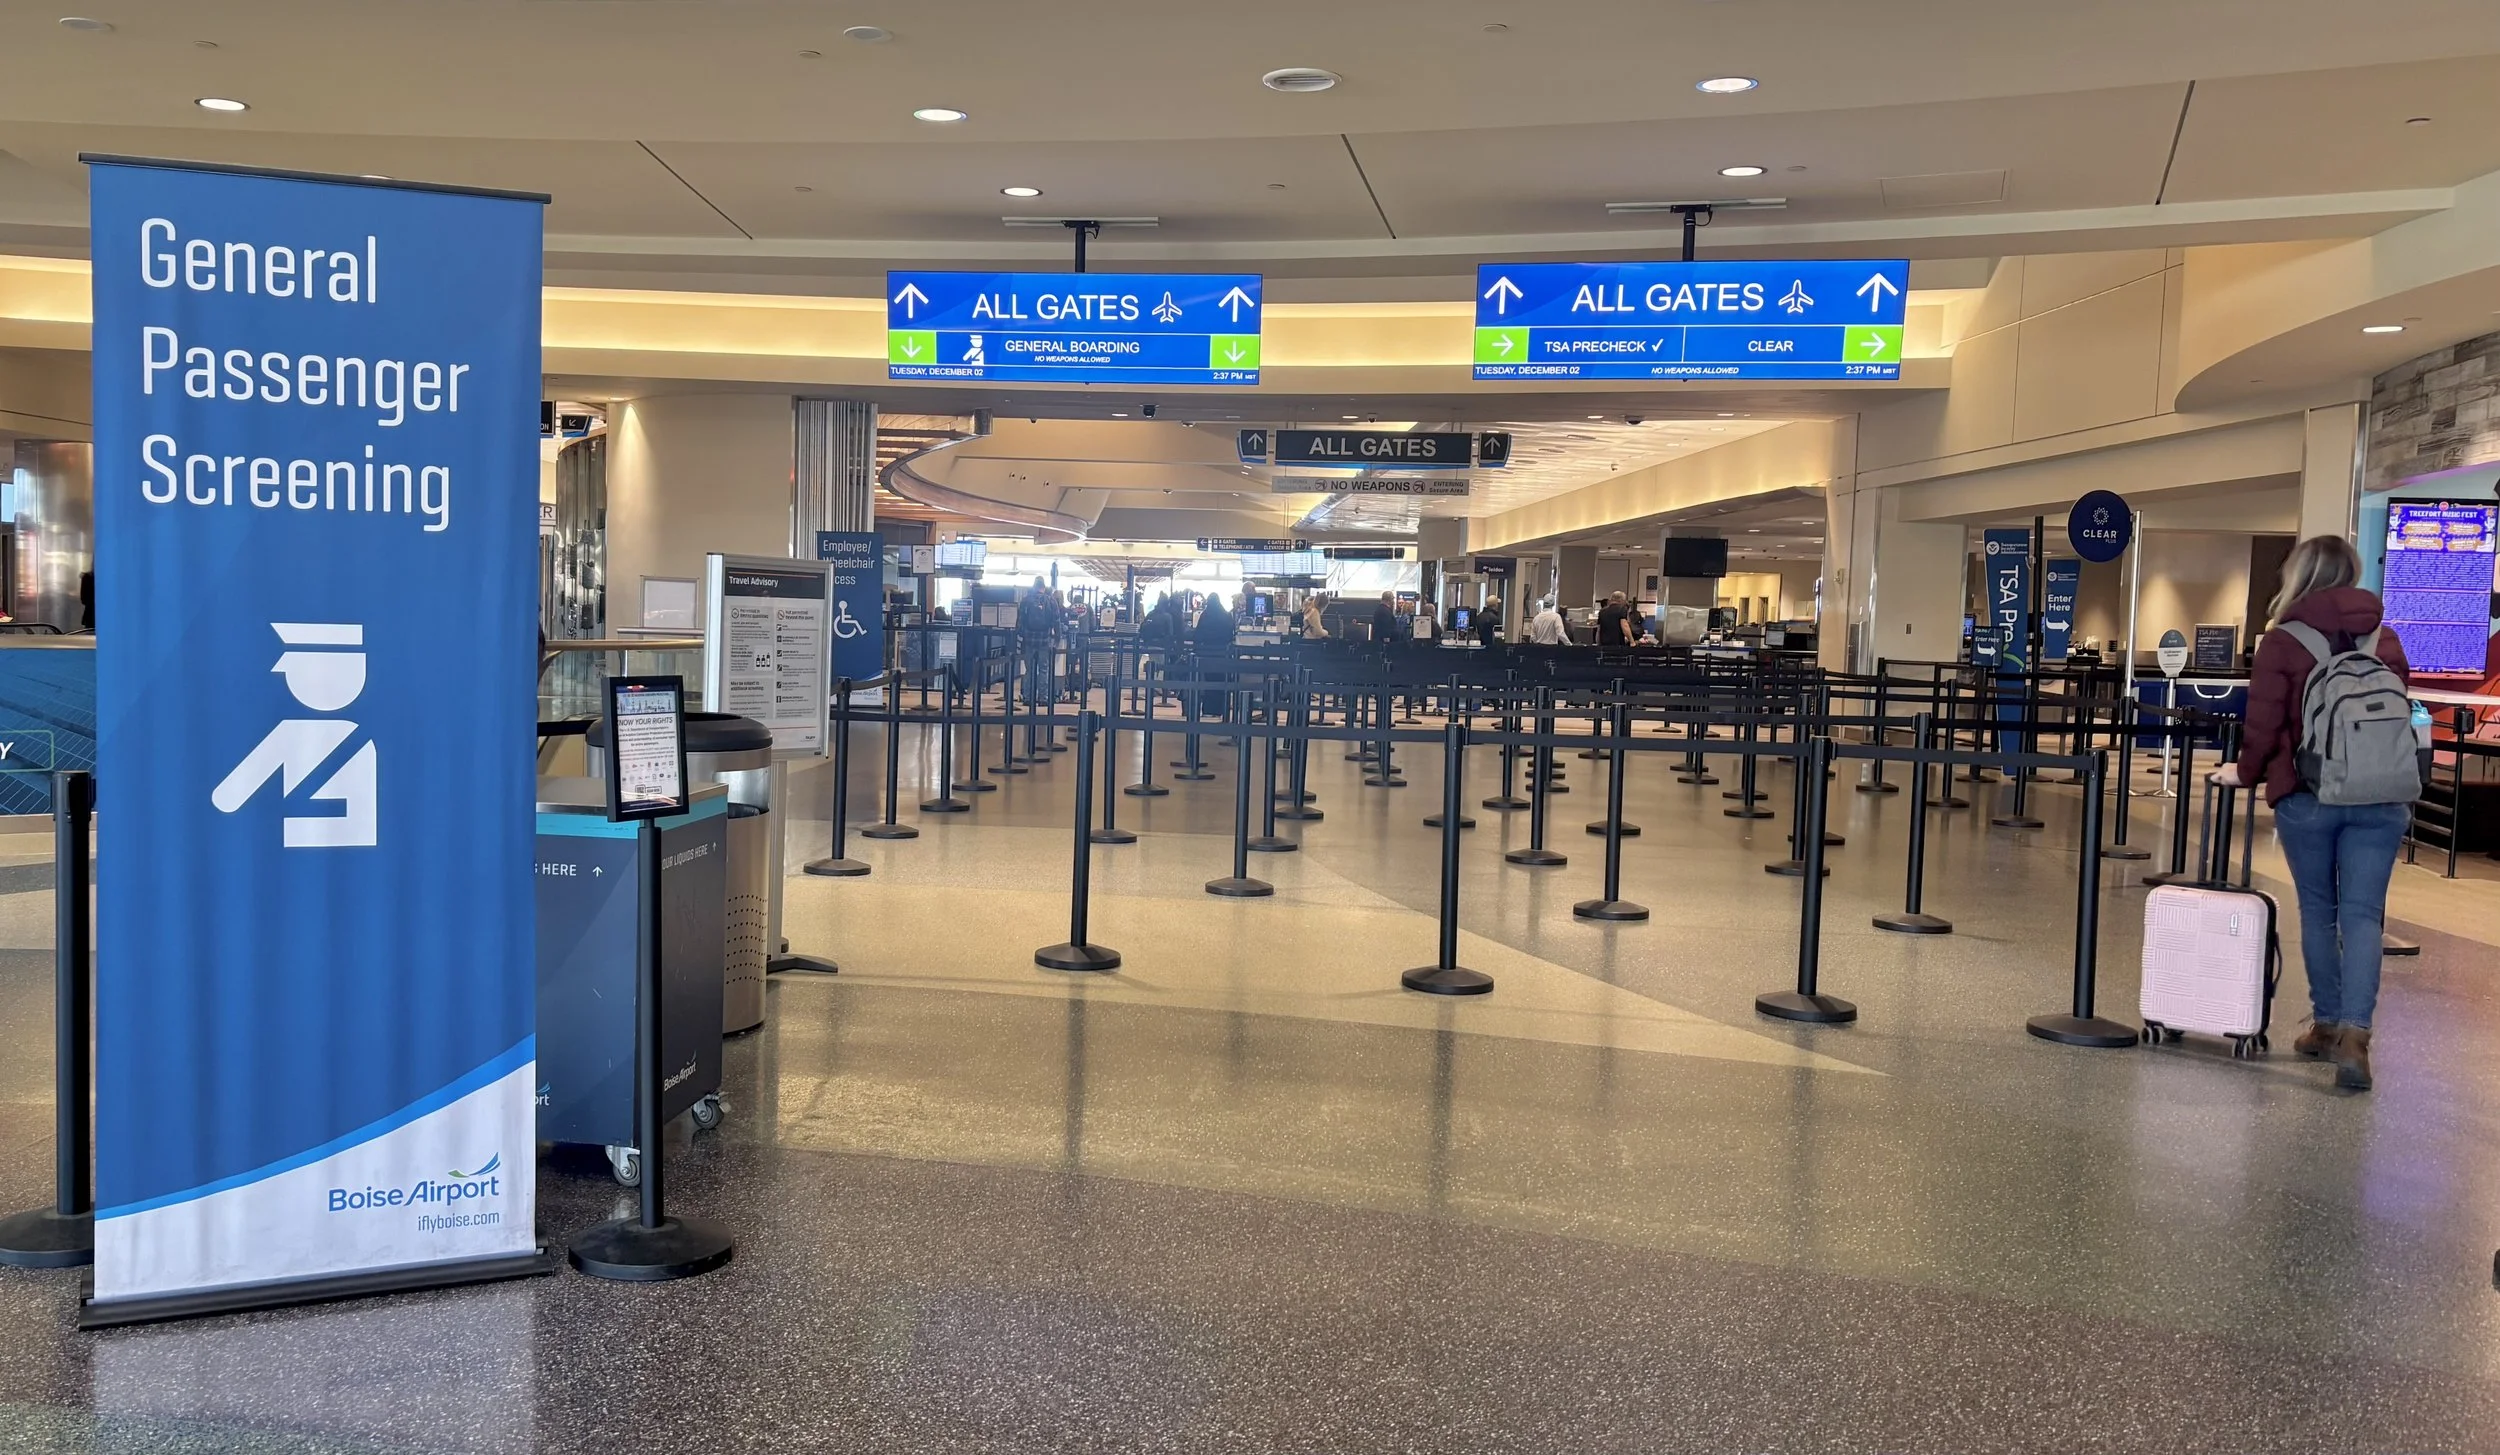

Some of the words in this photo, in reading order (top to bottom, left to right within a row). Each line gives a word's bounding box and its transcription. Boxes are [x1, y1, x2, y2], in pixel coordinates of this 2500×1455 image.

[141, 217, 376, 303] General
[1571, 283, 1635, 312] ALL
[1645, 282, 1765, 311] GATES
[972, 293, 1028, 319] ALL
[1036, 293, 1140, 321] GATES
[1005, 340, 1067, 353] GENERAL
[1070, 341, 1140, 353] BOARDING
[1545, 341, 1570, 353] TSA
[1573, 341, 1646, 352] PRECHECK
[1748, 340, 1794, 352] CLEAR
[143, 326, 470, 426] Passenger
[890, 366, 928, 376] TUESDAY,
[929, 368, 973, 376] DECEMBER
[1475, 367, 1517, 375] TUESDAY,
[1518, 366, 1568, 374] DECEMBER
[1569, 366, 1580, 374] 02
[1845, 366, 1864, 374] 2:37
[1866, 366, 1881, 374] PM
[1308, 437, 1354, 456] ALL
[1360, 438, 1437, 457] GATES
[142, 434, 450, 532] Screening
[1331, 481, 1348, 490] NO
[1351, 481, 1410, 491] WEAPONS
[2083, 529, 2117, 538] CLEAR
[823, 539, 872, 555] Employee/
[823, 556, 875, 569] heelchair
[728, 576, 750, 585] Travel
[750, 578, 779, 588] Advisory
[834, 575, 856, 585] cess
[1999, 564, 2019, 605] TSA
[2047, 594, 2073, 603] Enter
[2048, 603, 2071, 611] Here
[662, 857, 673, 870] OUR
[673, 849, 695, 866] LIQUIDS
[695, 843, 708, 859] HERE
[542, 863, 577, 876] HERE
[664, 1073, 679, 1091] Boise
[677, 1061, 697, 1083] Airport
[329, 1186, 404, 1212] Boise
[403, 1176, 500, 1206] Airport
[418, 1212, 500, 1233] iflyboise.com
